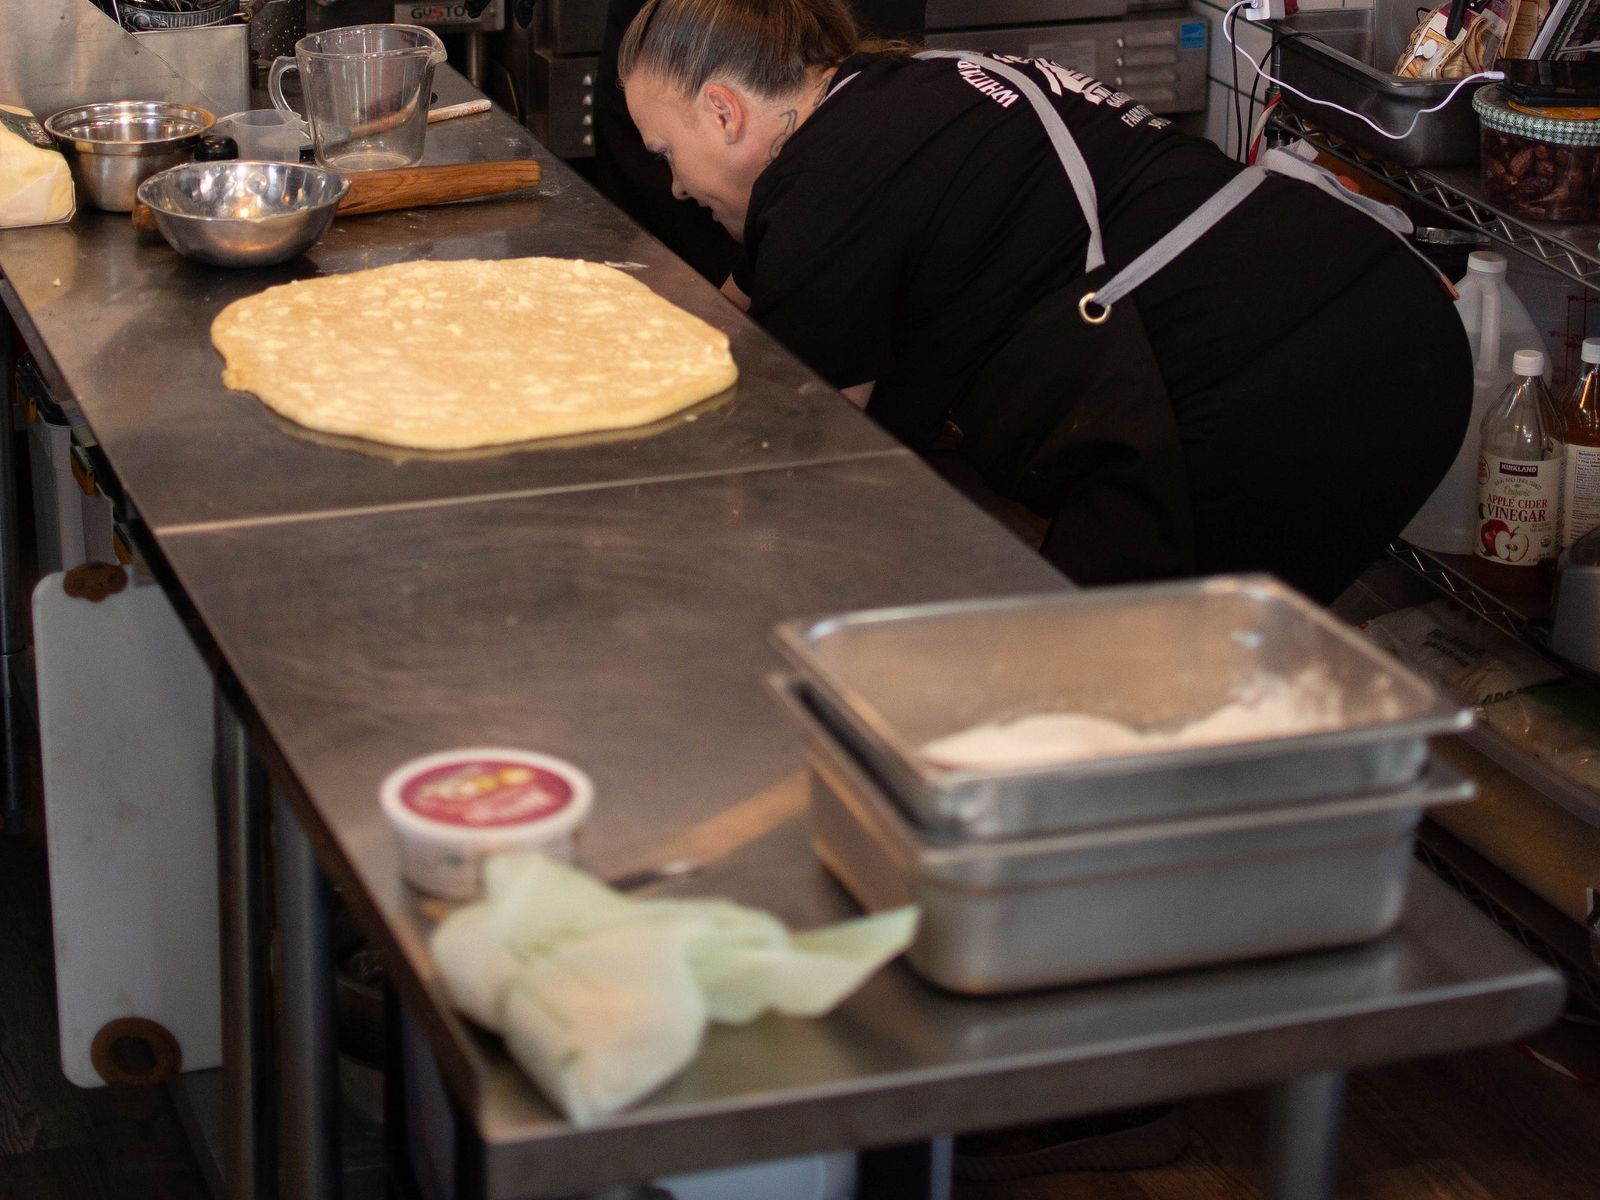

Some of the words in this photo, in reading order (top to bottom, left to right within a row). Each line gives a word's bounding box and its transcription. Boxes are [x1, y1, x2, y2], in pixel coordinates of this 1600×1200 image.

[1501, 463, 1537, 473] KIRKLAND
[1487, 493, 1515, 508] APPLE
[1517, 499, 1548, 509] CIDER
[1487, 503, 1546, 522] VINEGAR
